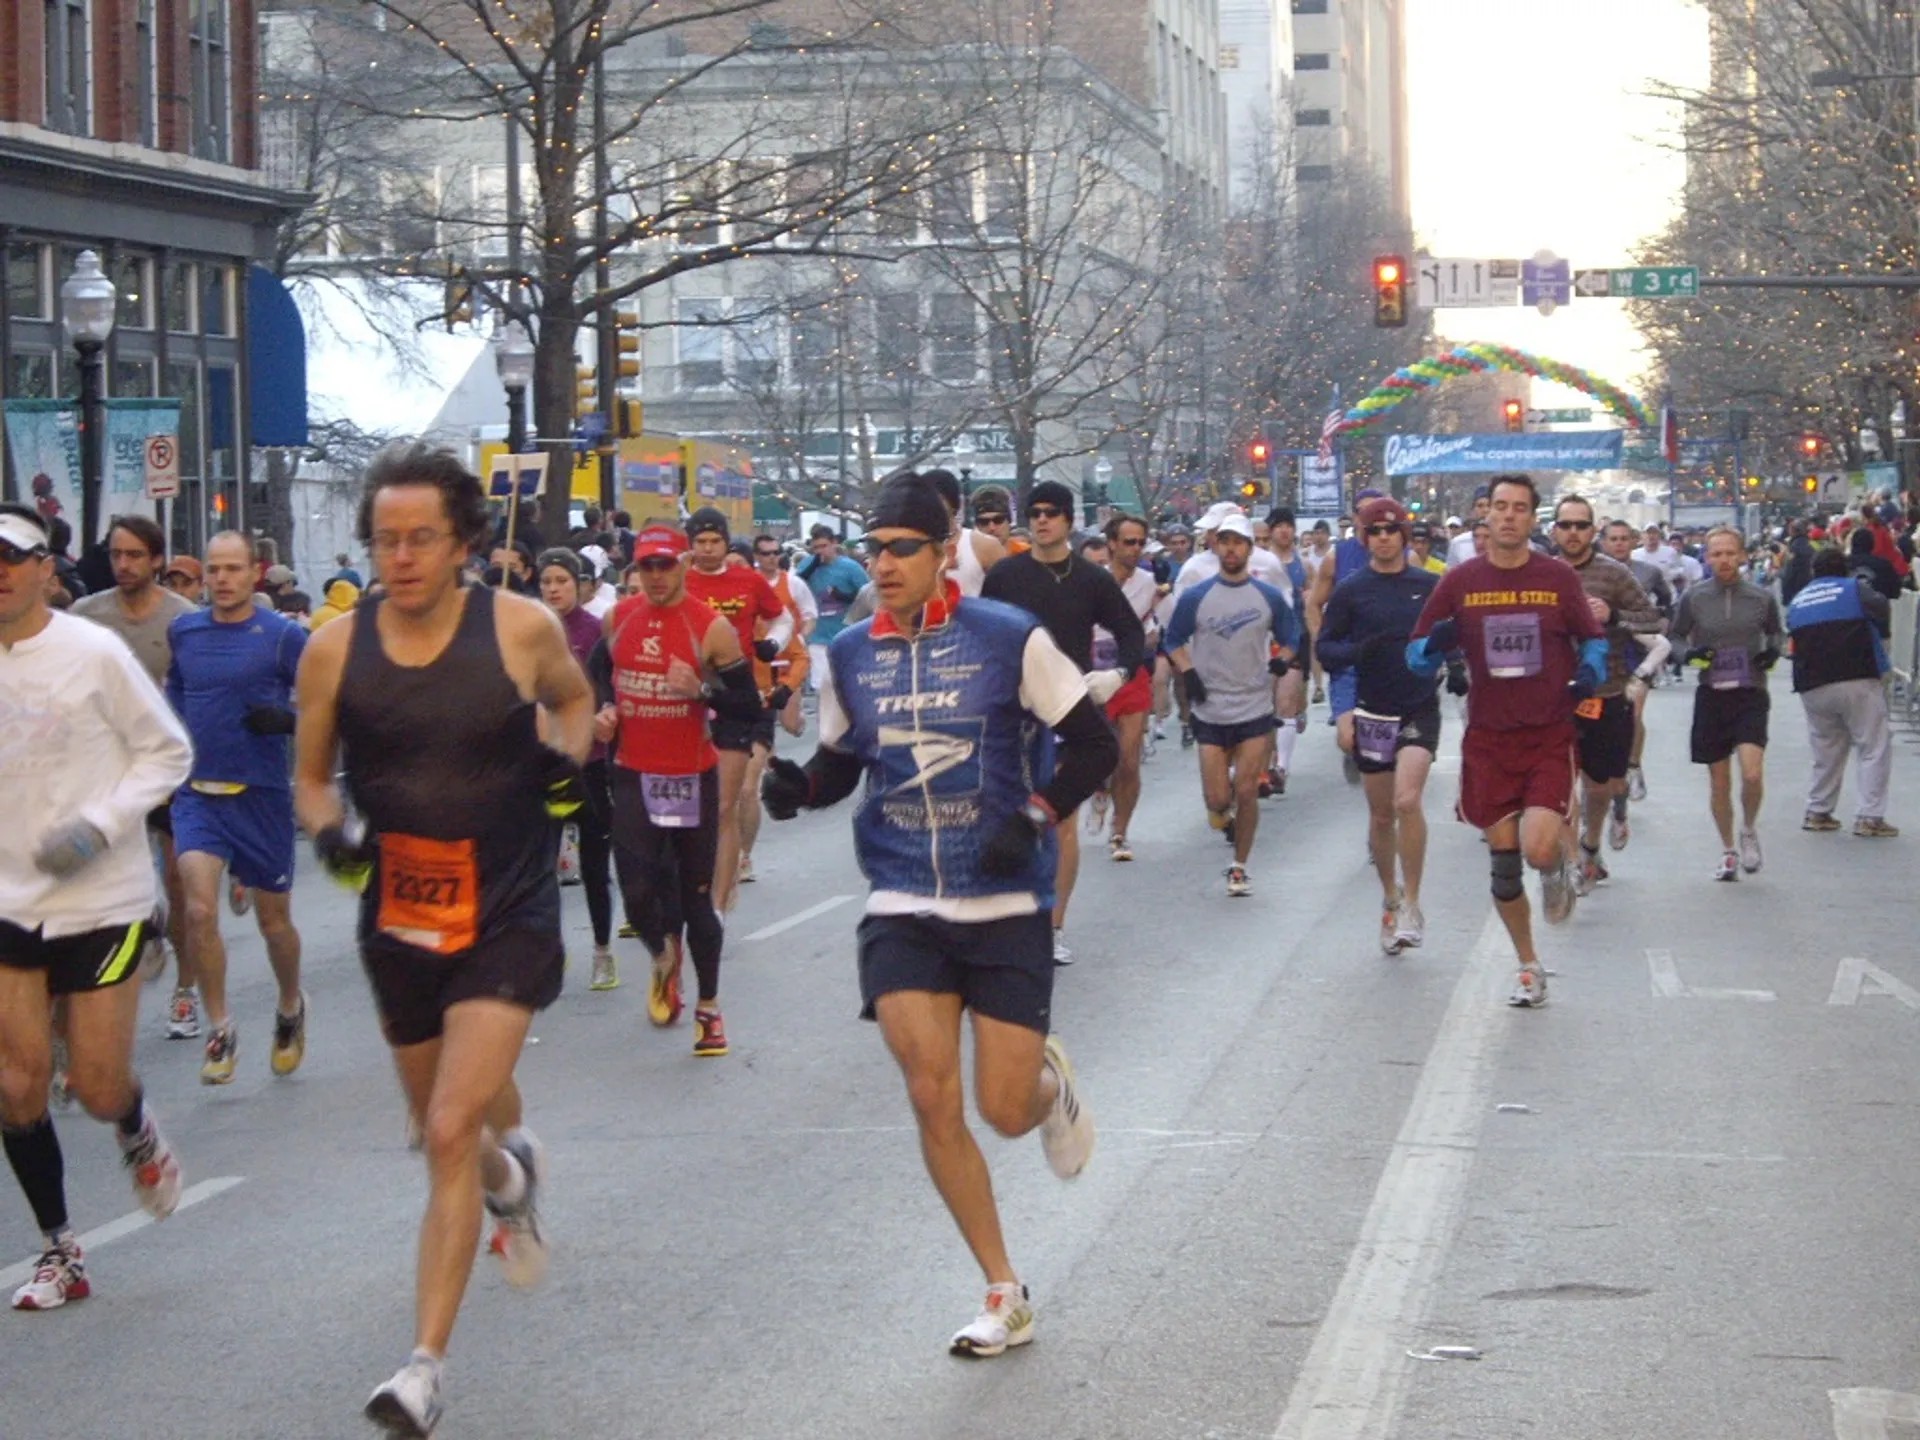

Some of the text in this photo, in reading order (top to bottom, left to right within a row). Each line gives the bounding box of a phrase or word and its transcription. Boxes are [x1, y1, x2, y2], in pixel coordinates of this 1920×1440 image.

[1616, 272, 1634, 288] W
[1487, 449, 1552, 461] COWTOWN
[1463, 590, 1559, 607] ARIZONA STATE
[1491, 634, 1534, 653] 4447
[874, 689, 961, 715] TREK
